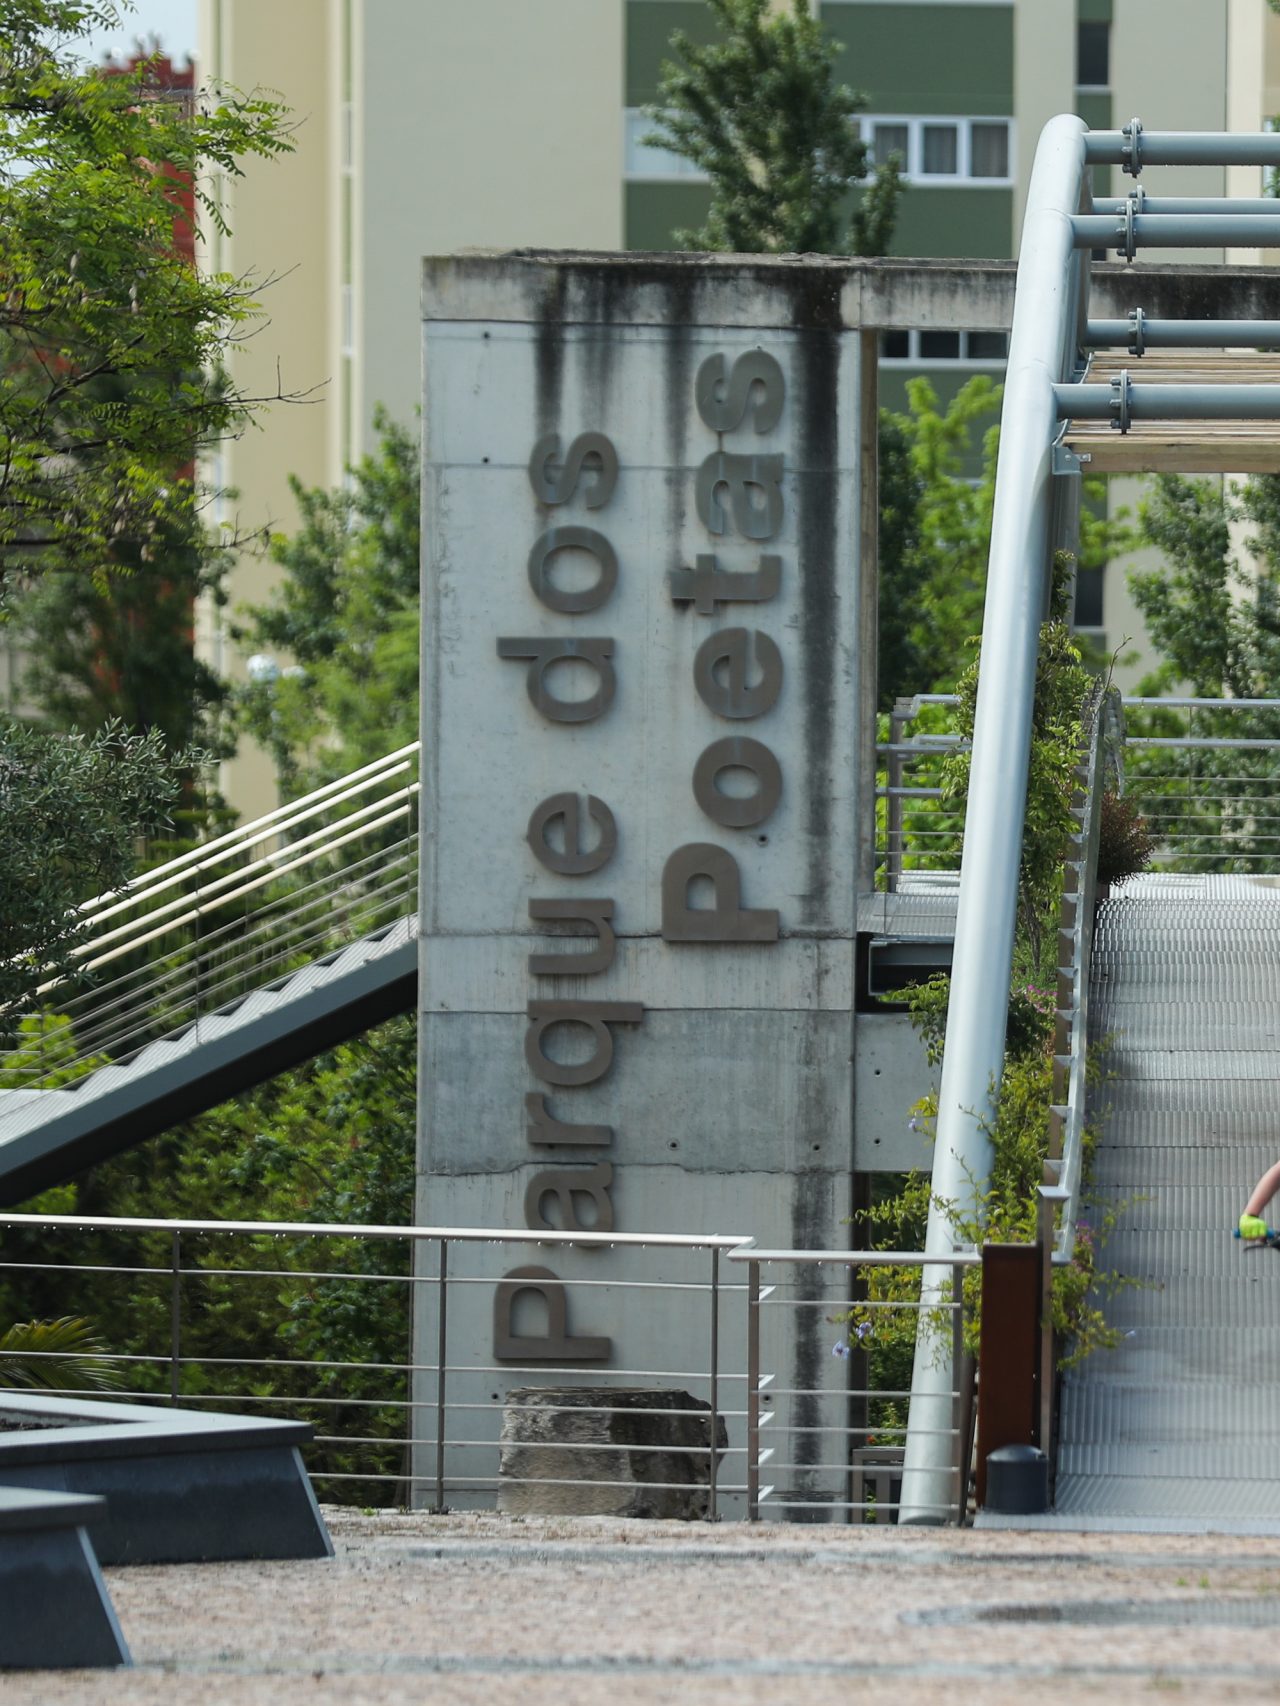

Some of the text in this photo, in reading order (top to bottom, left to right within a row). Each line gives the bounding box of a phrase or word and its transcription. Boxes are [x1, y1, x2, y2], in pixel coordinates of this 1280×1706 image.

[493, 431, 645, 1360] Parque dos
[664, 349, 786, 943] Poetas
